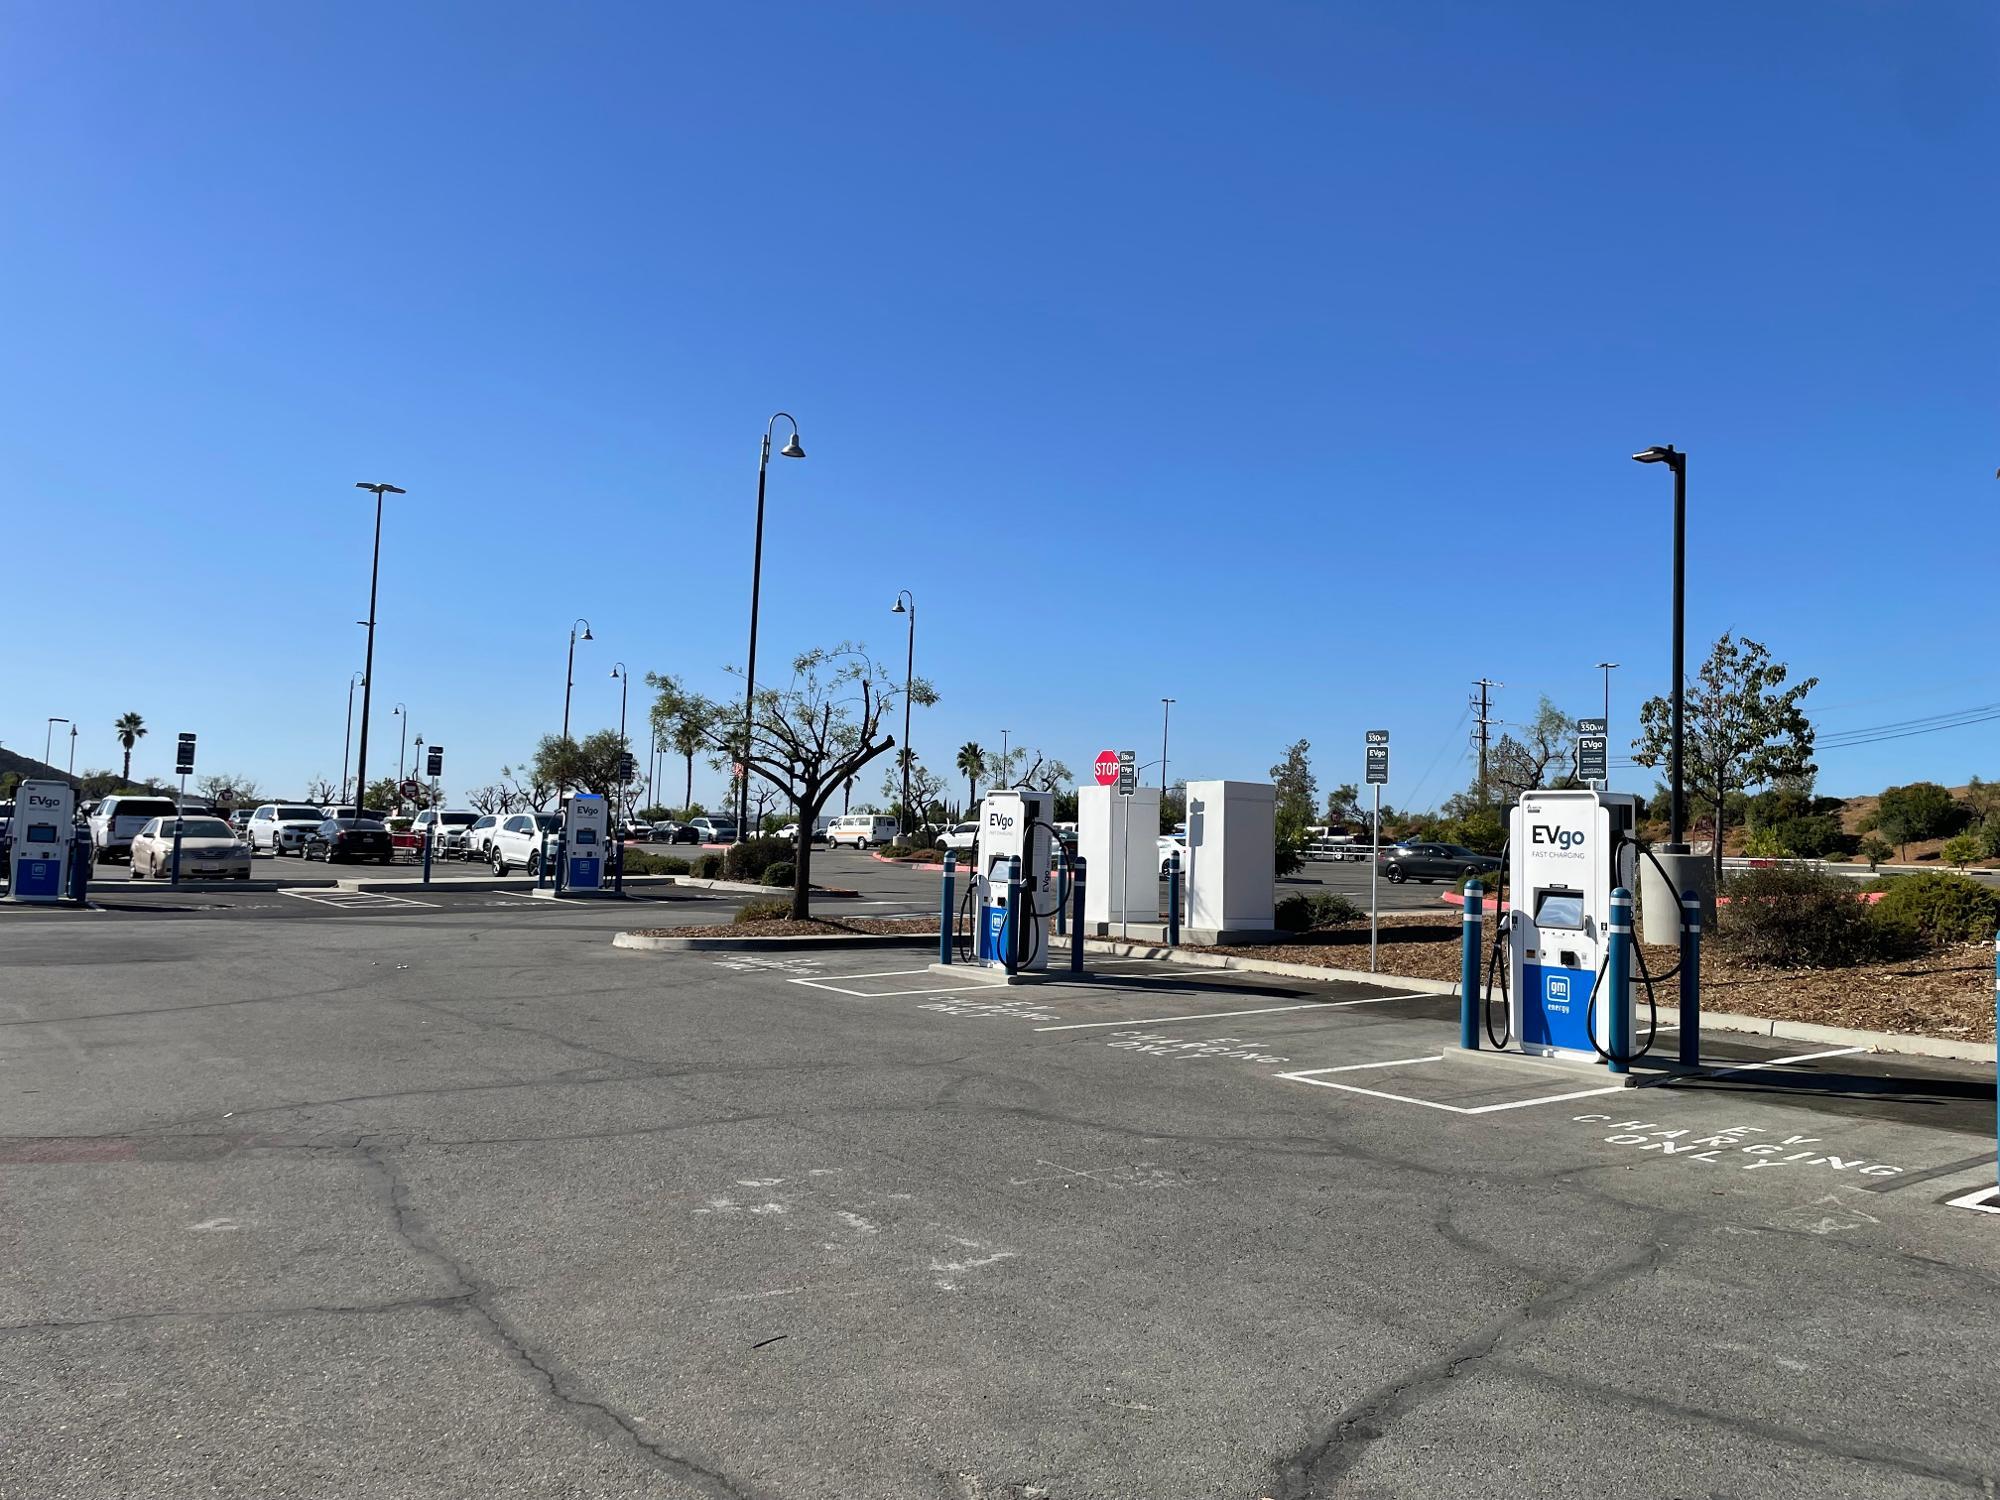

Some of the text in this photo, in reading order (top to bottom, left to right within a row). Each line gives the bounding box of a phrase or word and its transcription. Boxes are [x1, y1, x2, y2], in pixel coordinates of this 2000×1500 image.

[1582, 740, 1603, 750] EVgo
[1369, 749, 1386, 758] EVgo
[1095, 762, 1119, 776] STOP
[1120, 766, 1133, 774] EVgo
[29, 795, 60, 809] EVgo
[576, 805, 599, 817] EVgo
[989, 813, 1014, 831] EVgo
[1532, 824, 1585, 850] EVgo
[1549, 851, 1585, 860] CHARGING
[1042, 870, 1050, 893] EVgo
[1550, 981, 1567, 997] gm
[1547, 1003, 1570, 1015] energy
[1107, 1041, 1212, 1060] ONLY
[1110, 1031, 1290, 1063] CHARGING
[1572, 1114, 1904, 1177] CHARGING
[1603, 1134, 1788, 1169] ONLY
